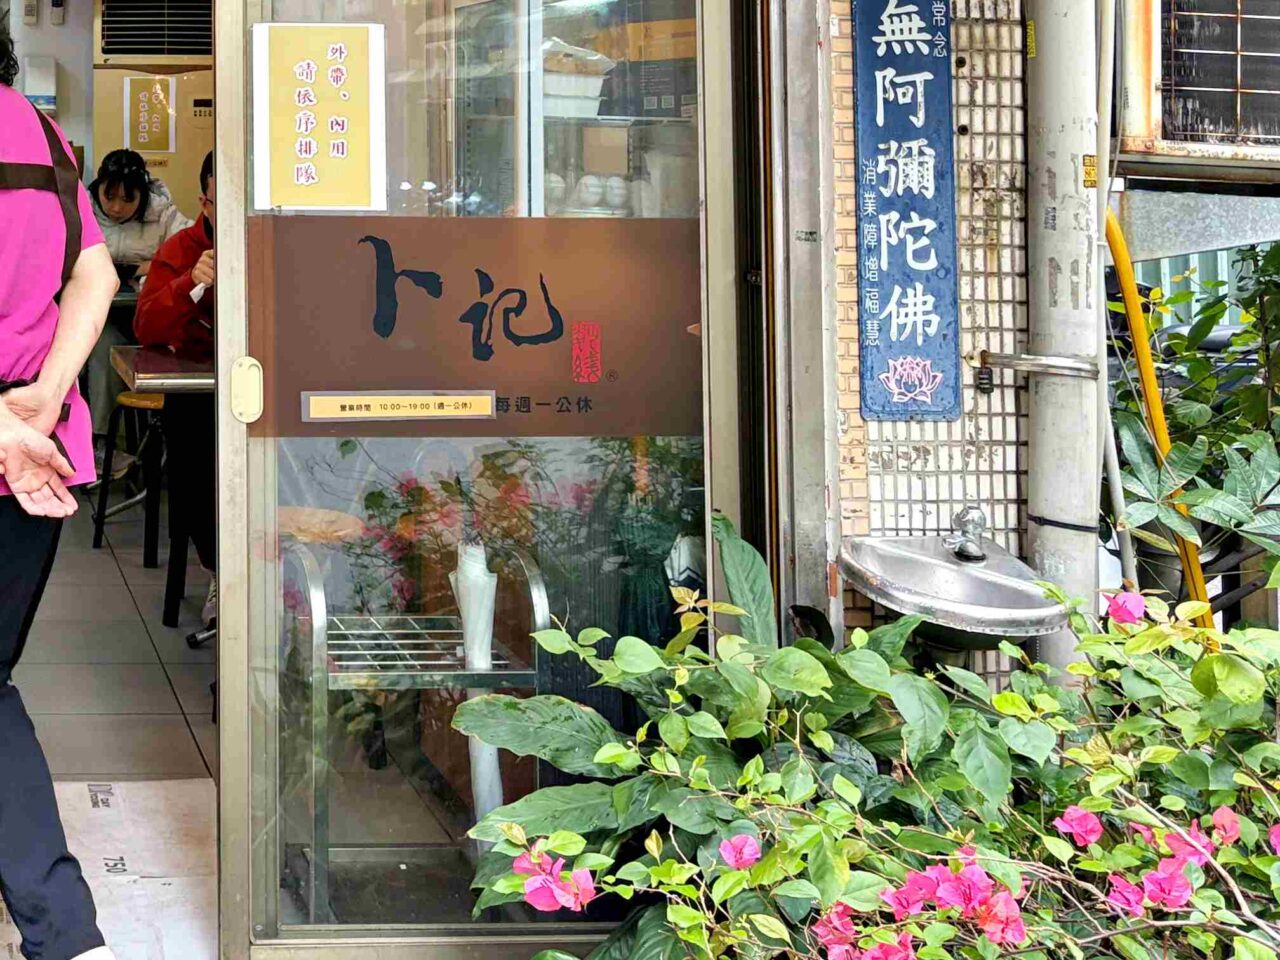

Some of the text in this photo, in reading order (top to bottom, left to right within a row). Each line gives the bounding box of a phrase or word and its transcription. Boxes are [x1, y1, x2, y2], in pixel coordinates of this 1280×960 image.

[294, 61, 320, 187] 請依序排隊
[358, 234, 565, 362] 卜記
[861, 158, 880, 347] 消業障增福慧
[495, 396, 594, 414] 每週一公休
[103, 855, 128, 874] 750
